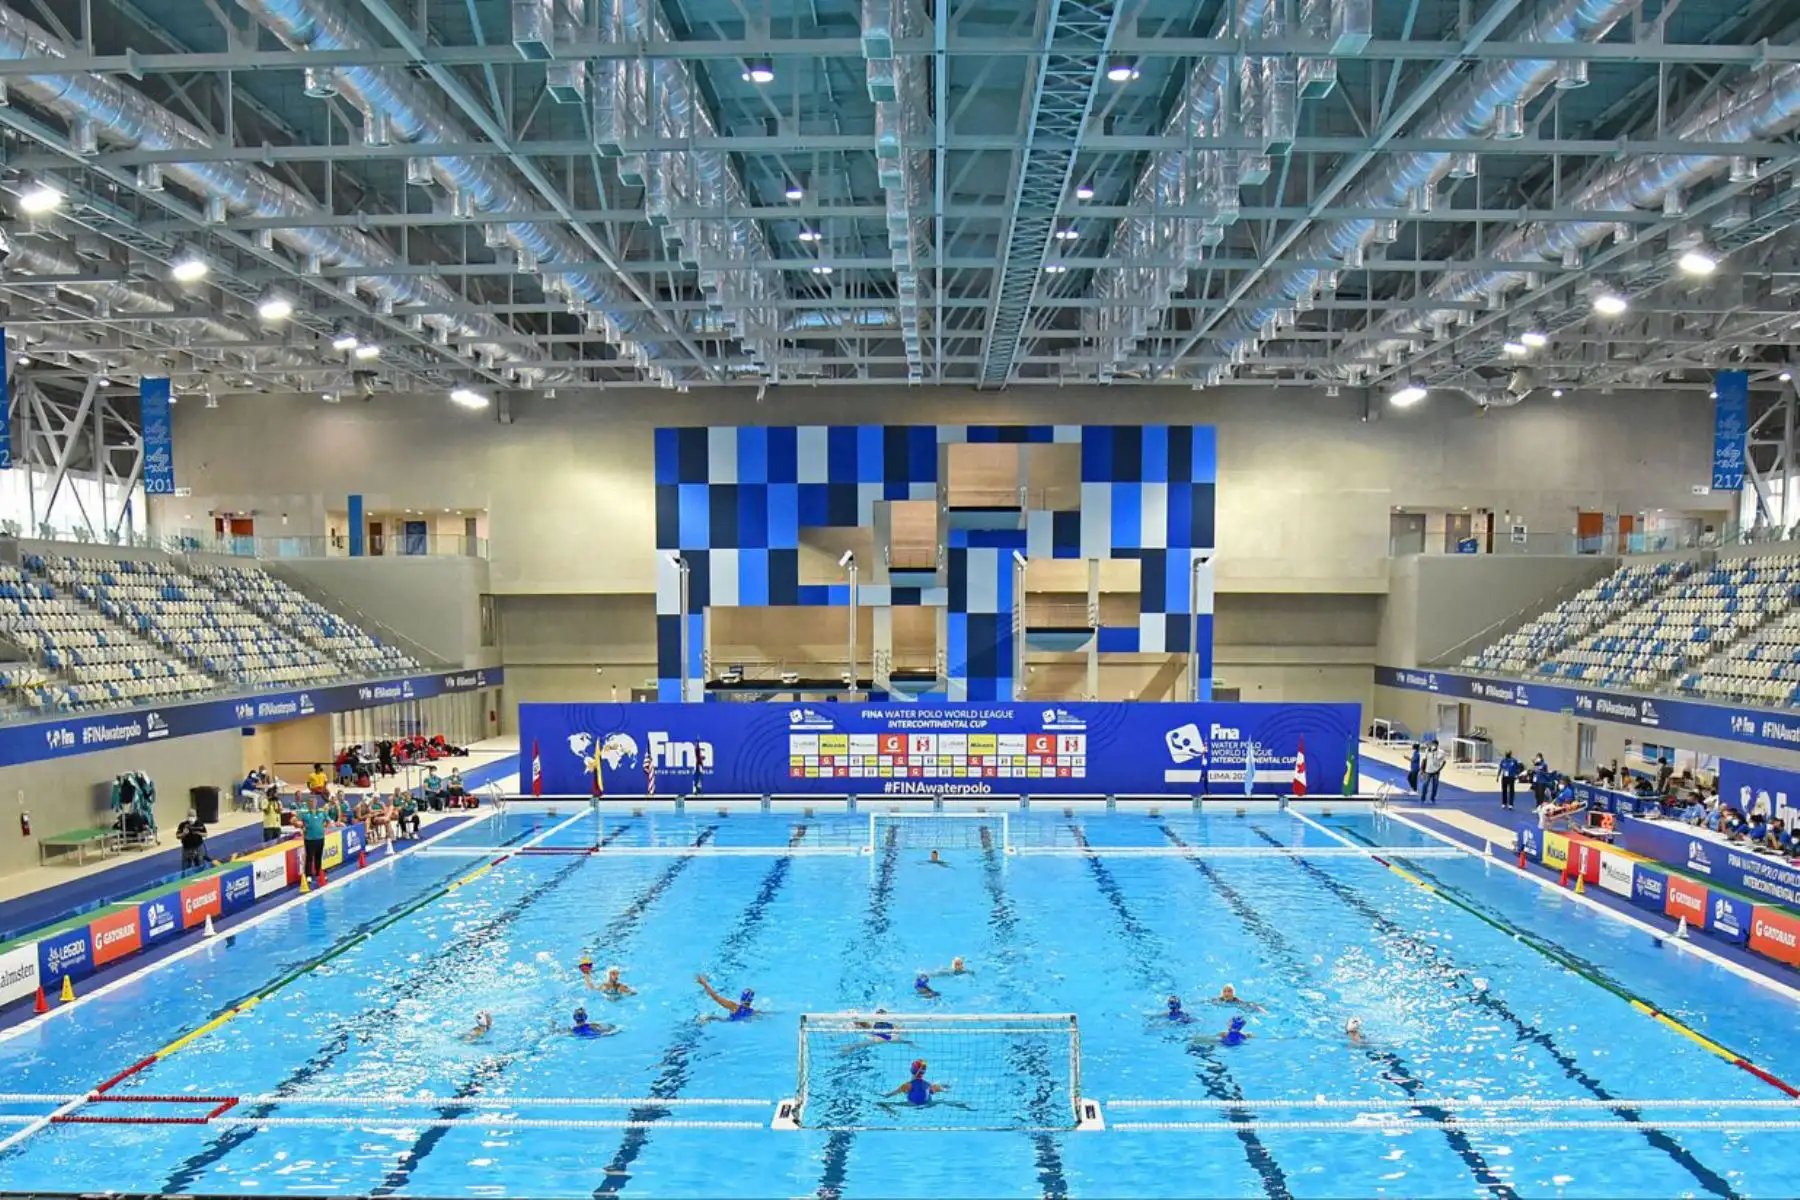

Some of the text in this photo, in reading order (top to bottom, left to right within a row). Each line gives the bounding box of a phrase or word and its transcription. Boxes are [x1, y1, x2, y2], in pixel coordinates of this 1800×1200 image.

[146, 478, 174, 492] 201
[1714, 474, 1744, 488] 217
[861, 710, 1014, 719] FINA WATER POLO WORLD LEAGUE
[888, 719, 988, 729] INTERCONTINENTAL CUP
[82, 720, 141, 745] #FINAwaterpolo
[1211, 749, 1241, 757] WORLD
[1210, 772, 1230, 780] LIMA
[884, 780, 991, 795] #FINAwaterpolo
[103, 922, 136, 945] GATORADE
[1764, 924, 1797, 948] GATORADE
